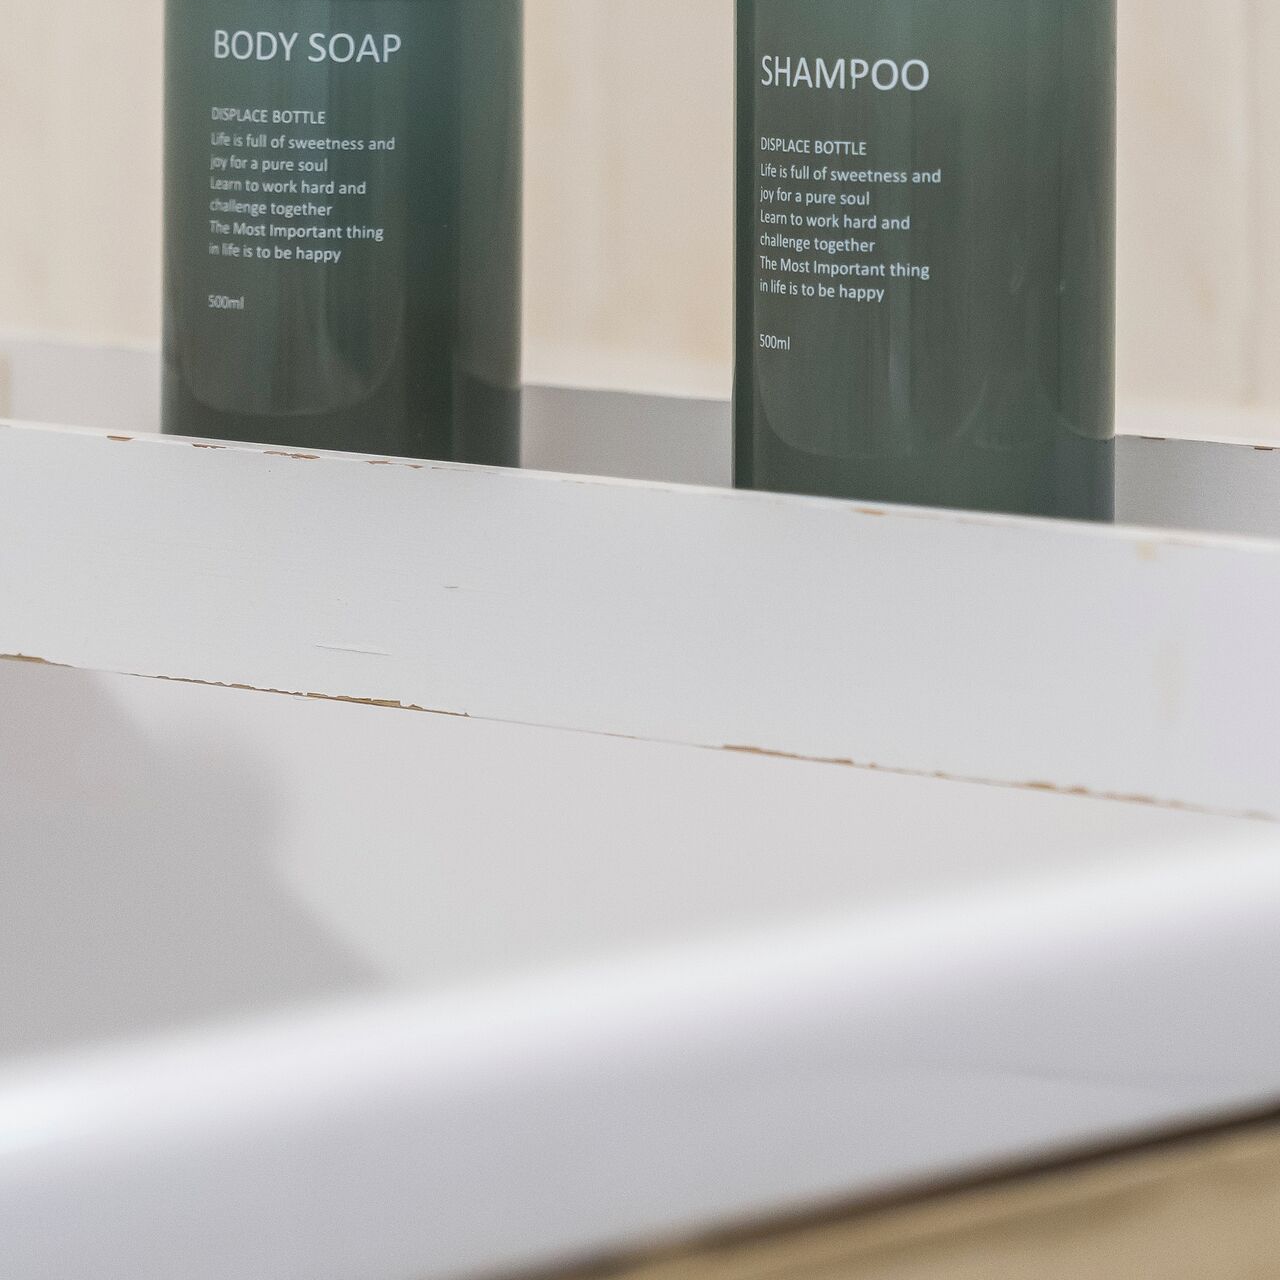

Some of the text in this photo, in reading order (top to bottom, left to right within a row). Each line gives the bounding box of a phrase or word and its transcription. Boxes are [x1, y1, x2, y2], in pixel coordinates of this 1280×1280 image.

[213, 29, 402, 63] BODY SOAP
[760, 55, 930, 91] SHAMPOO
[211, 106, 326, 125] DISPLACE BOTTLE
[210, 131, 395, 150] Life is full of sweetness and
[760, 136, 867, 156] DISPLACE BOTTLE
[210, 155, 328, 173] joy for a pure soul
[760, 163, 941, 183] Life is full of sweetness and
[210, 177, 366, 195] Learn to work hard and
[760, 186, 870, 206] joy for a pure soul
[209, 199, 333, 218] challenge together
[760, 209, 910, 230] Learn to work hard and
[209, 219, 384, 242] The Most Important thing
[209, 242, 341, 264] in life is to be happy
[760, 232, 876, 255] challenge together
[760, 255, 930, 280] The Most Important thing
[760, 278, 885, 302] in life is to be happy
[208, 294, 245, 310] 500ml
[759, 334, 791, 351] 500ml
